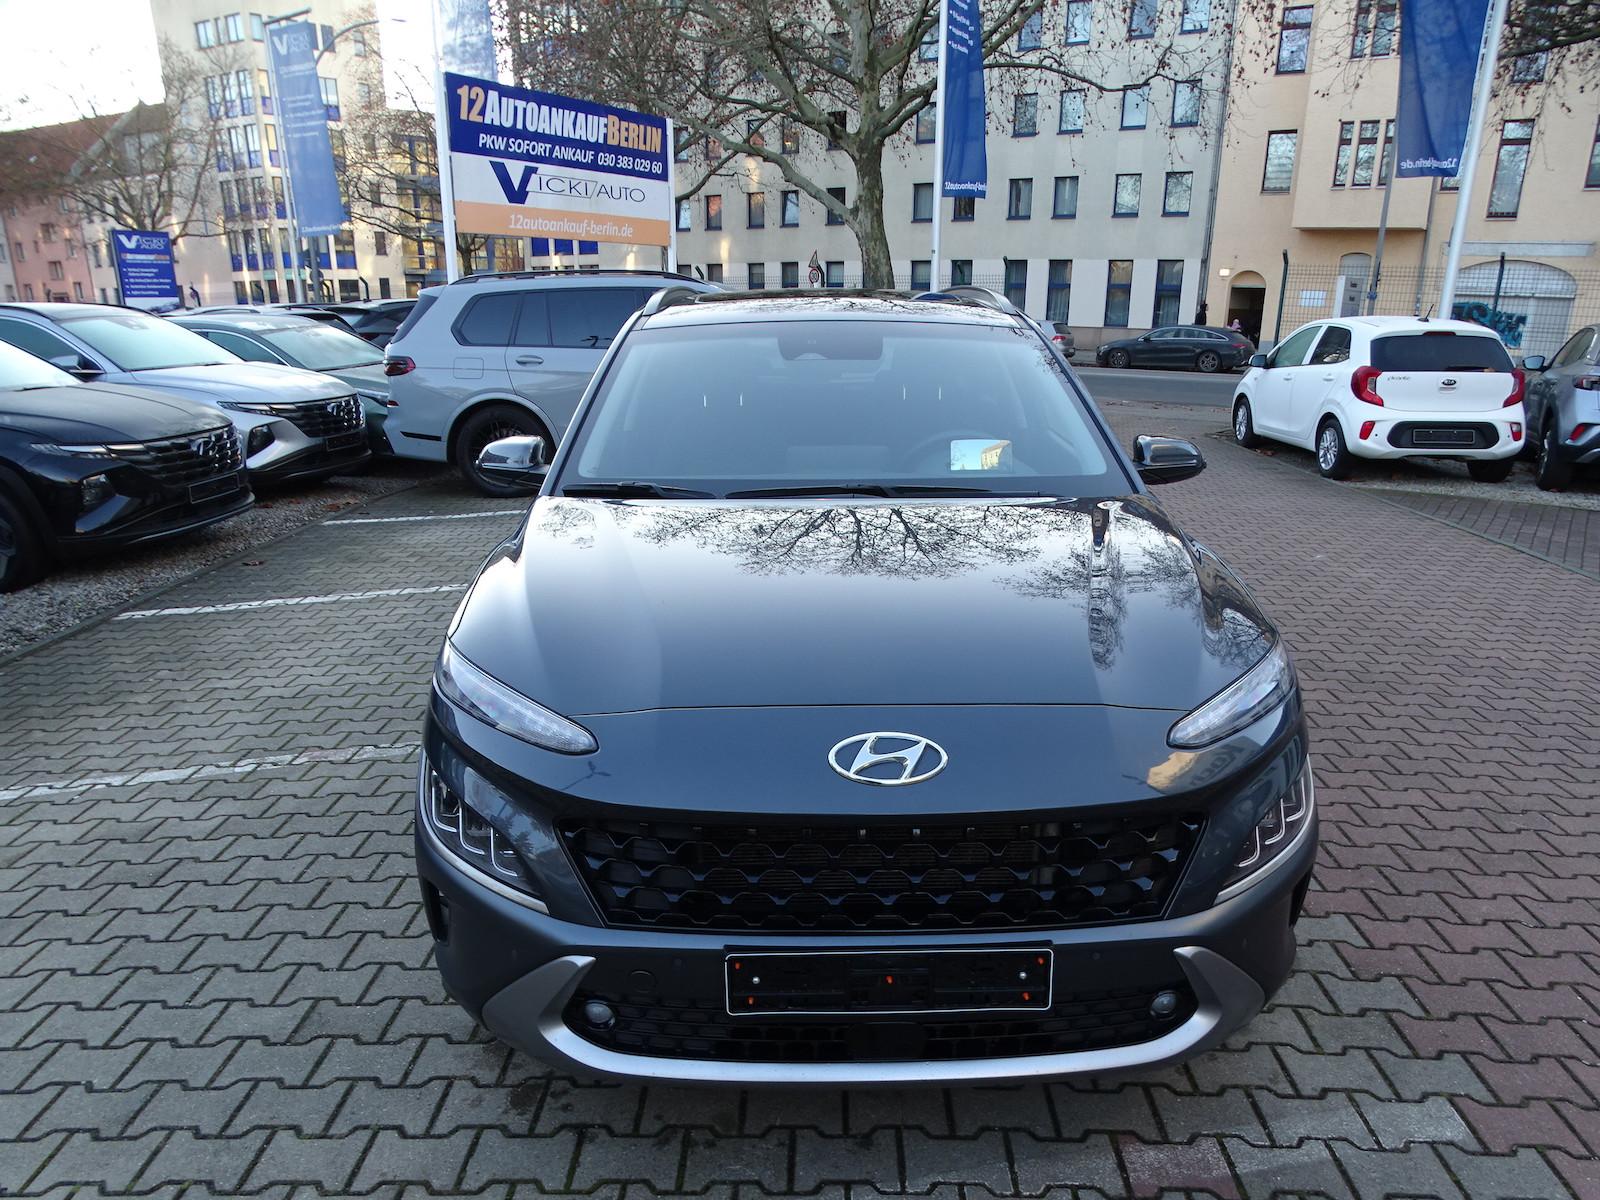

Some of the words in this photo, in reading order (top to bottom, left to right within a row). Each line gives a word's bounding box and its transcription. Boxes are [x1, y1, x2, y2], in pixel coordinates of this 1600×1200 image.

[457, 84, 662, 154] 12AUTOANKAUFBERLIN
[479, 133, 508, 151] PKW
[508, 137, 553, 158] SOFORT
[552, 144, 595, 164] ANKAUF
[597, 152, 616, 167] 030
[616, 155, 633, 170] 383
[634, 158, 650, 173] 029
[651, 161, 663, 174] 60
[489, 160, 590, 205] VICKI
[597, 184, 646, 203] AUTO
[509, 213, 634, 237] 12autoankauf-berlin.de
